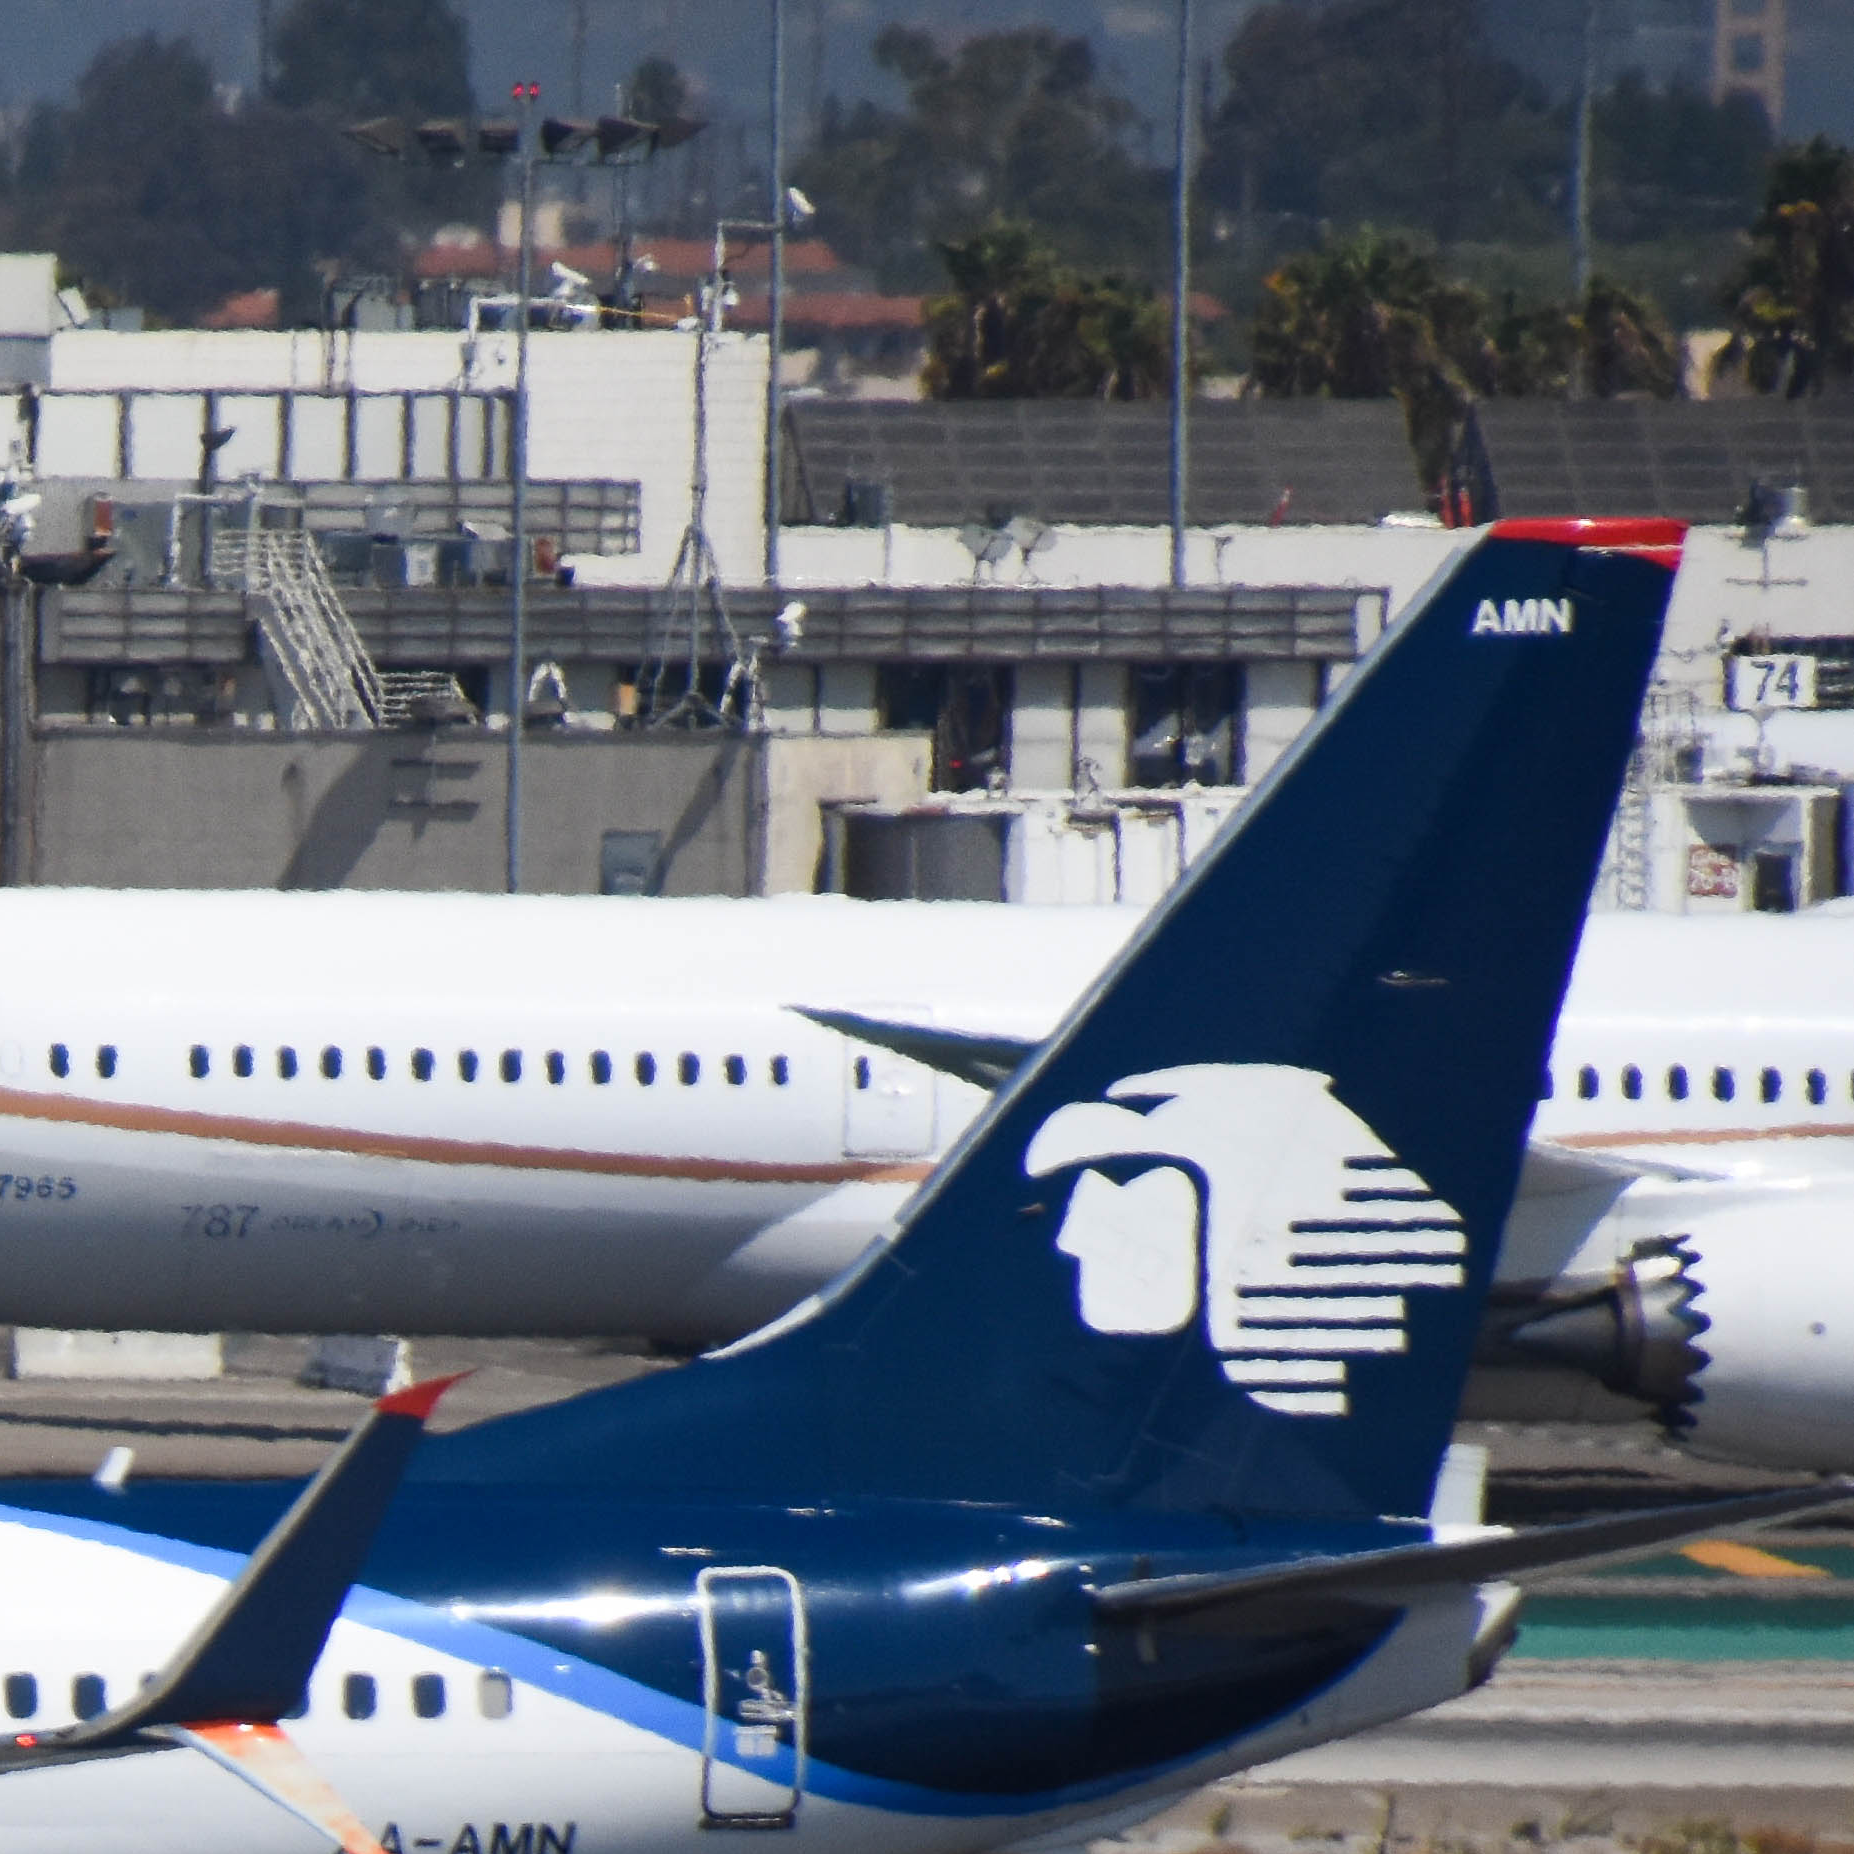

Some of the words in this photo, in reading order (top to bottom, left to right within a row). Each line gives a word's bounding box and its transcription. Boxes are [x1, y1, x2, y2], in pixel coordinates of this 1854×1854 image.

[1471, 598, 1574, 634] AMN
[1750, 660, 1799, 702] 74
[180, 1202, 260, 1239] 787
